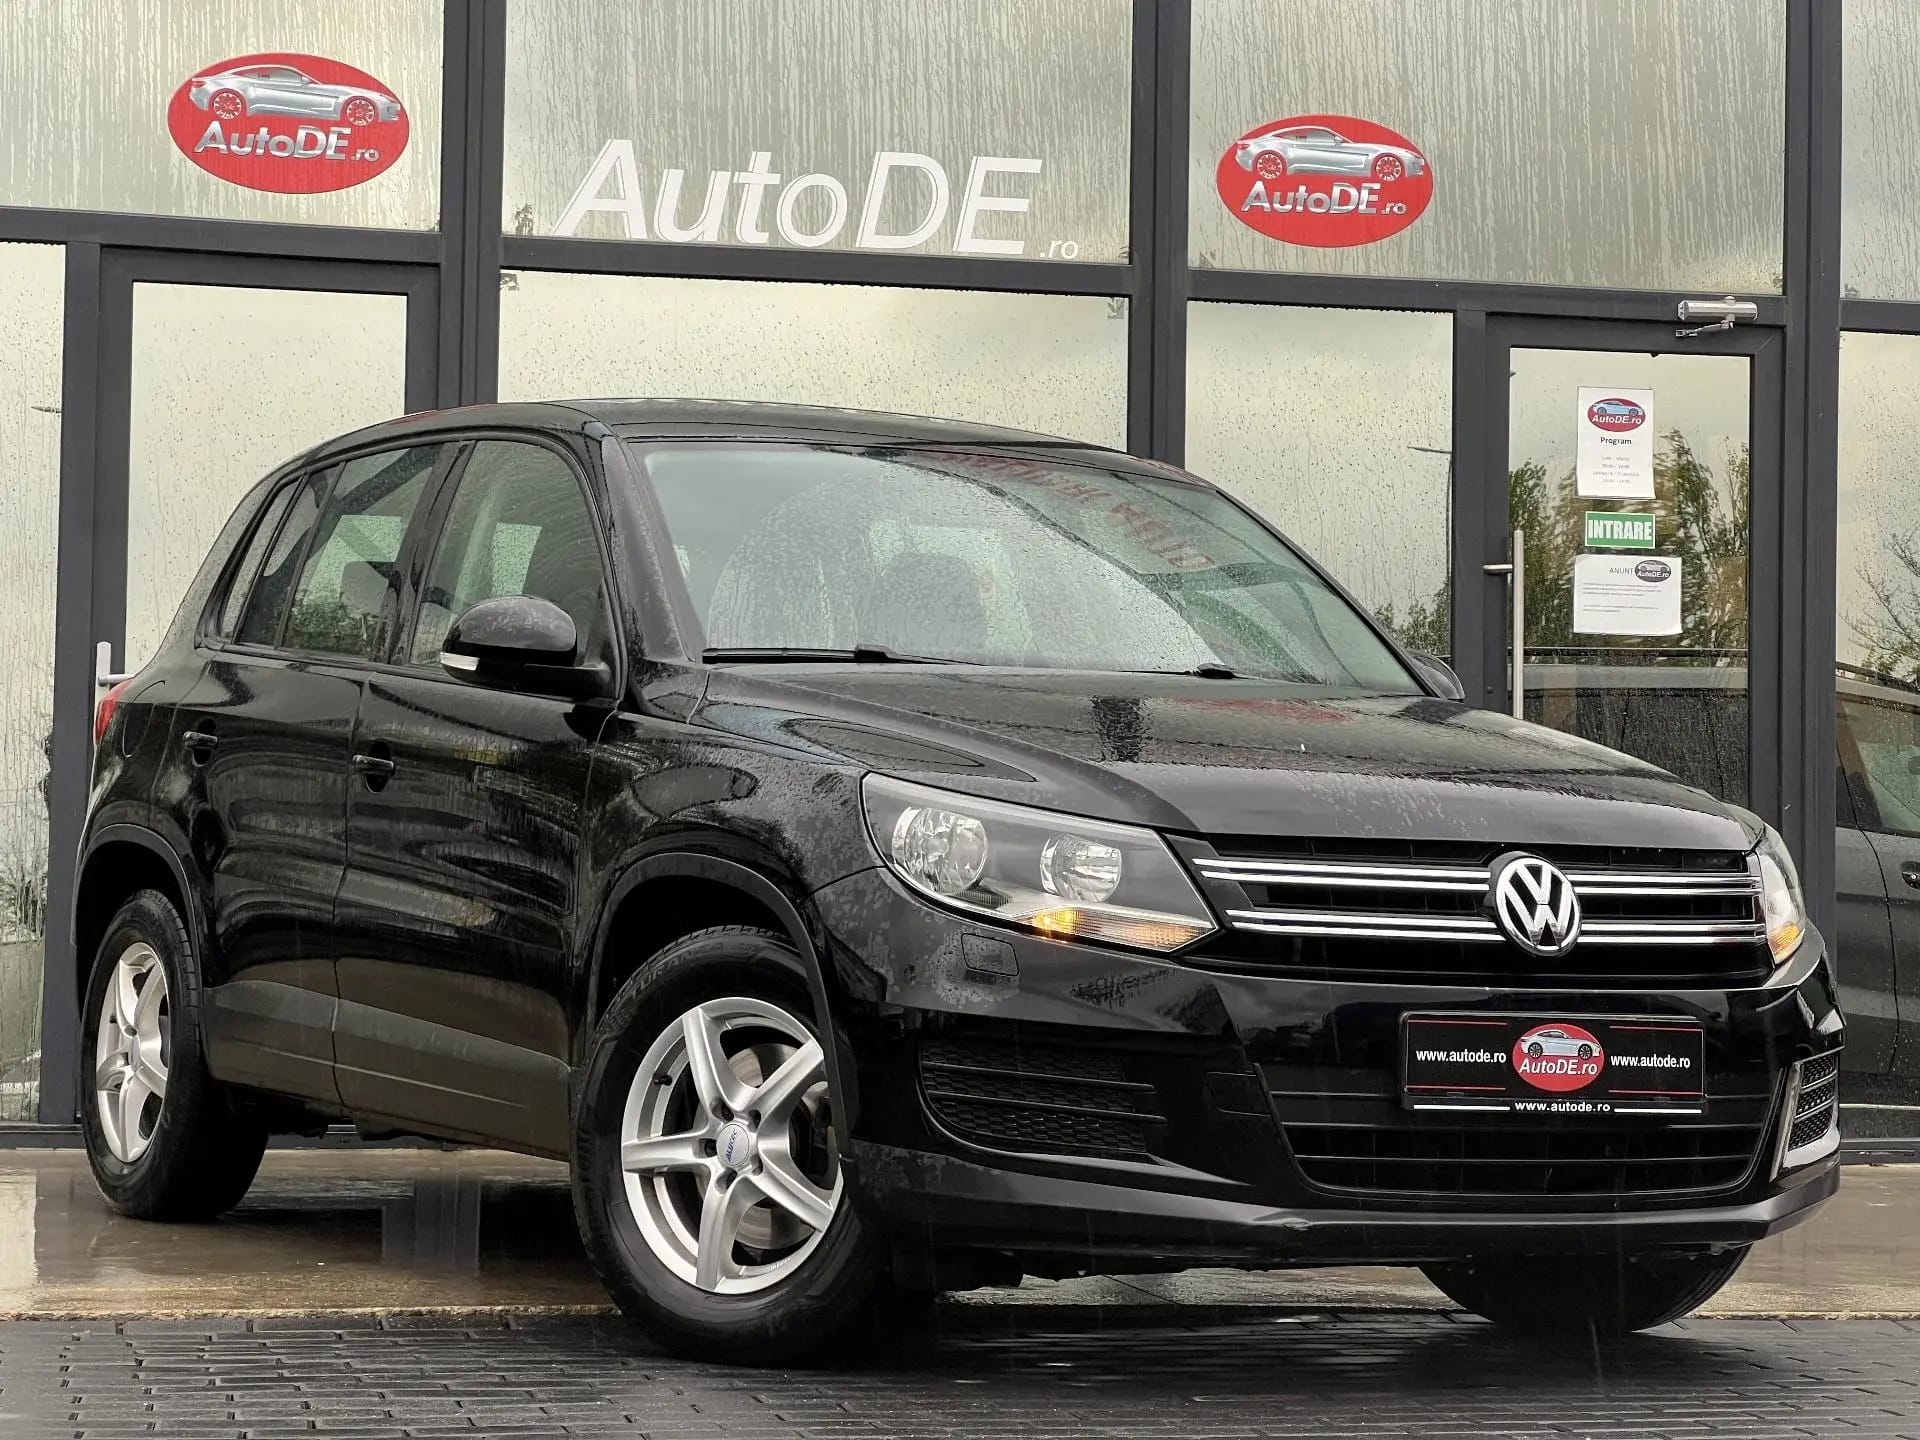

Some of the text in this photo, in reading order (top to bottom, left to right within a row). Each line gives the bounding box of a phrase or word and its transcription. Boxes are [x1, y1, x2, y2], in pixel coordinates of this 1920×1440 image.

[1591, 414, 1642, 425] AutoDE.ro
[1600, 437, 1632, 446] Program
[1588, 519, 1653, 541] INTRARE
[1416, 1049, 1507, 1064] www.autode.ro
[1610, 1054, 1691, 1069] www.autode.ro
[1519, 1058, 1598, 1076] AutoDE.ro
[1515, 1101, 1611, 1113] www.autode.ro
